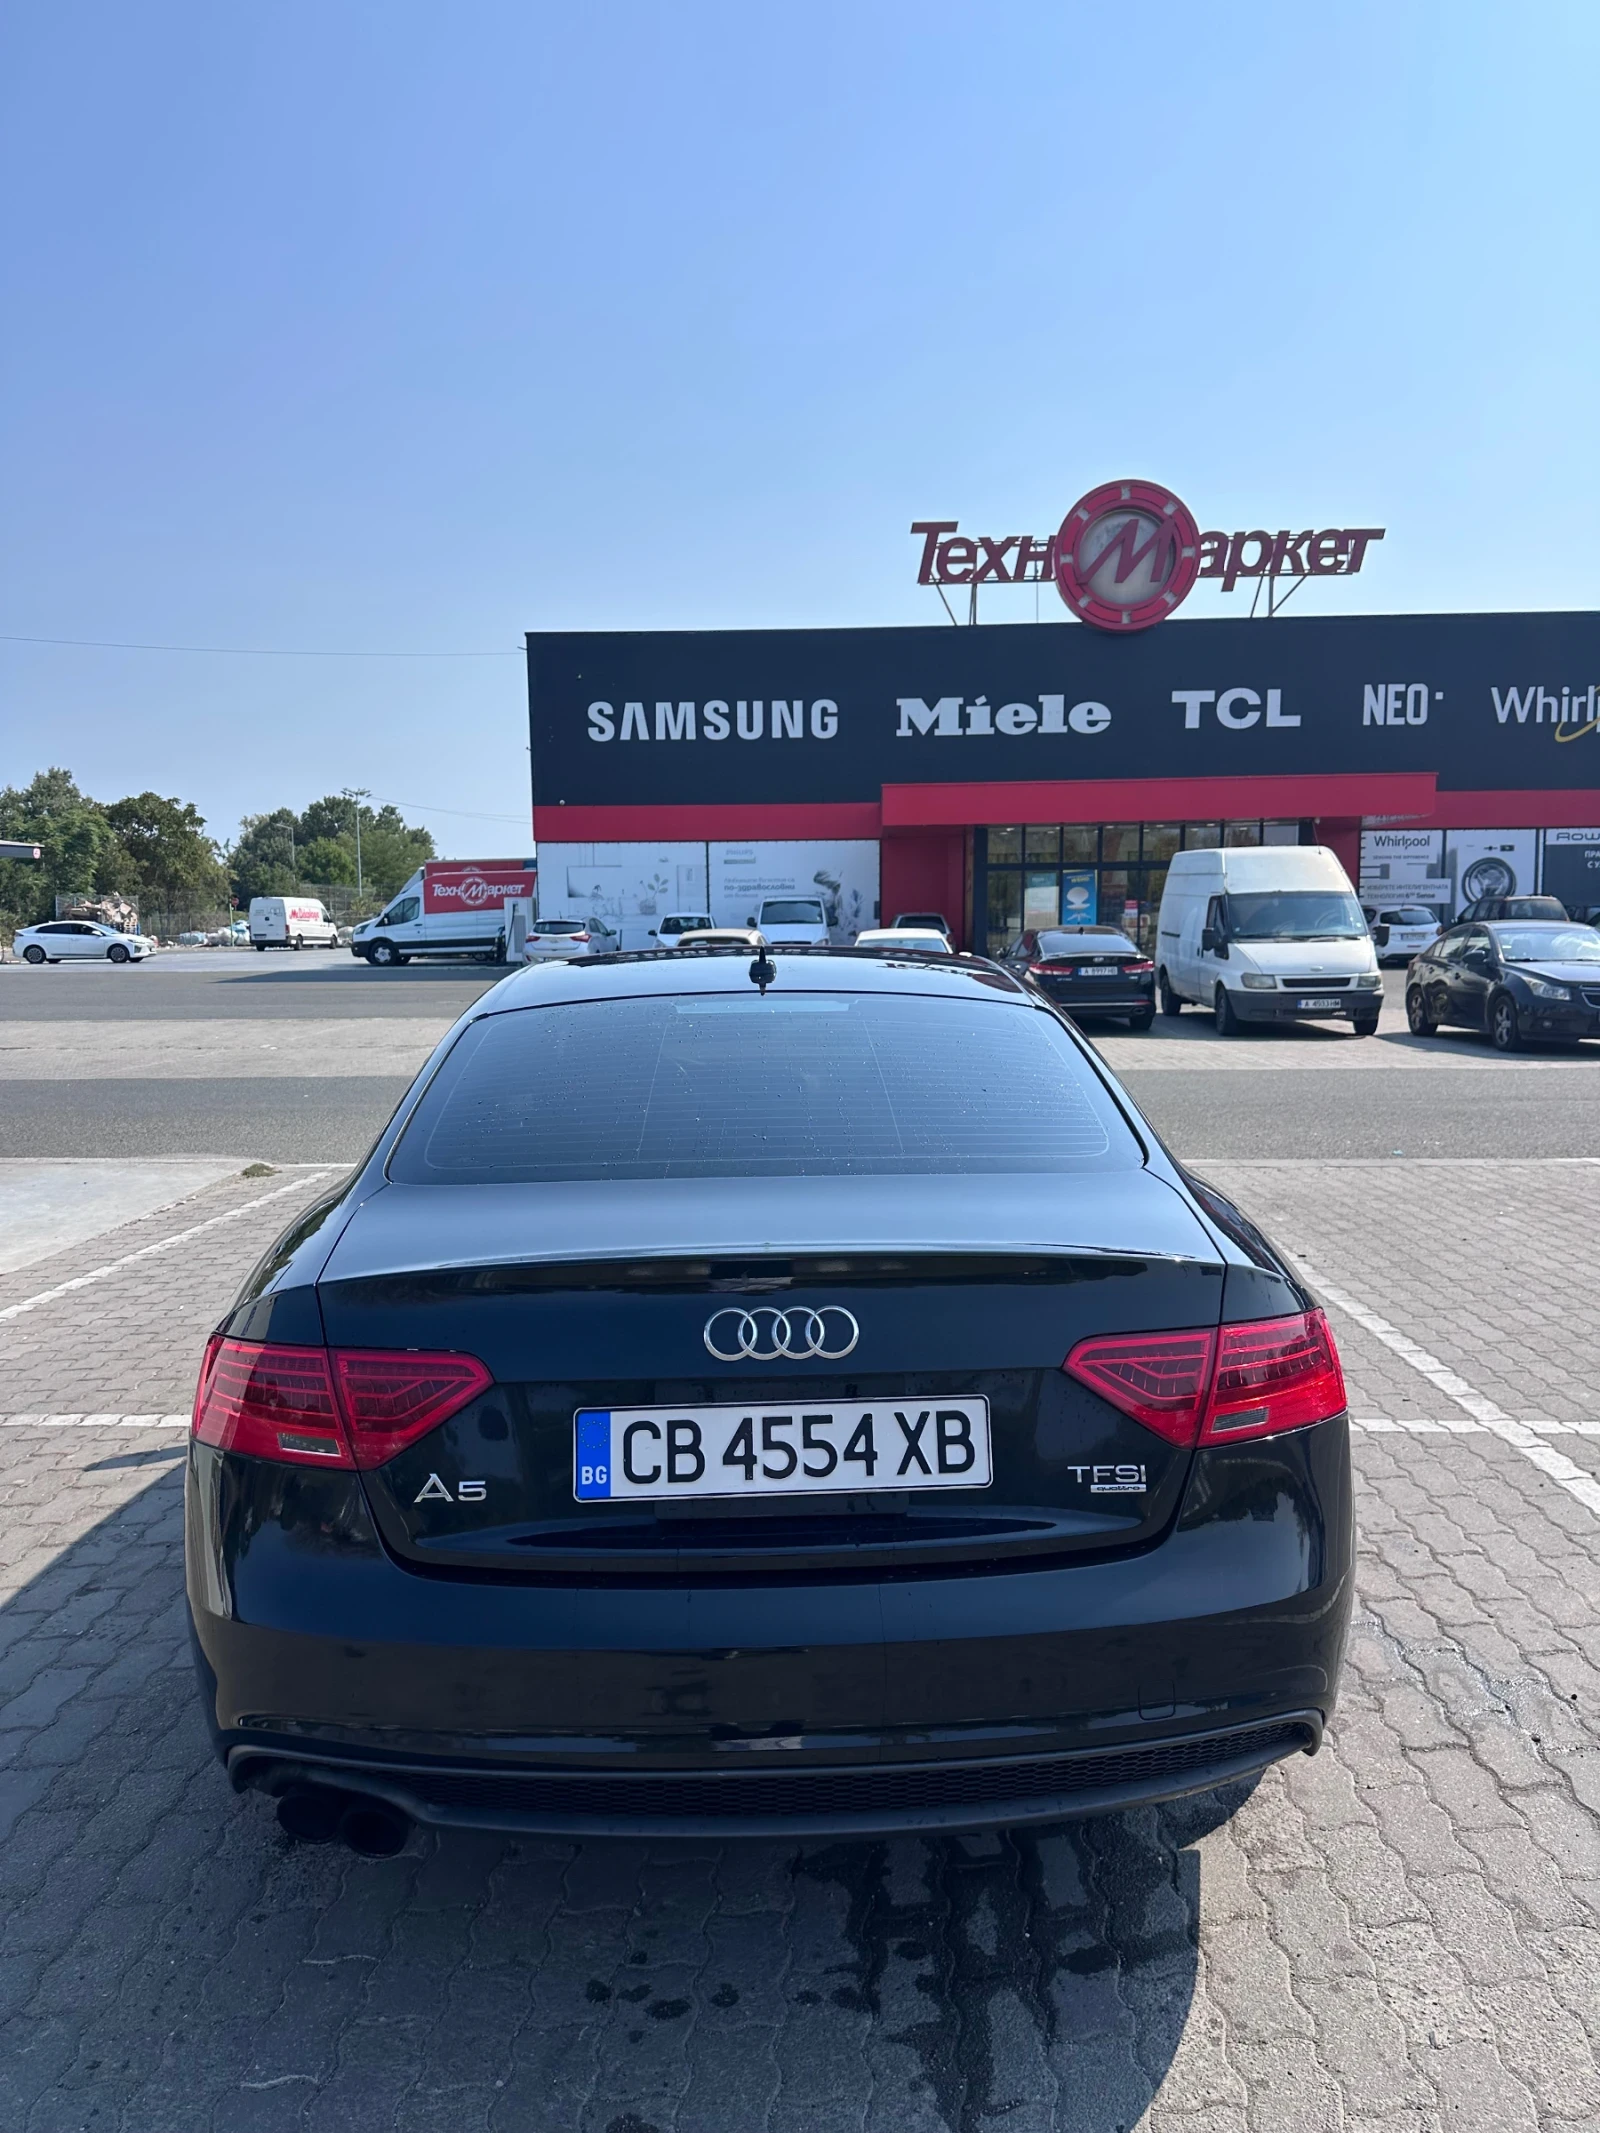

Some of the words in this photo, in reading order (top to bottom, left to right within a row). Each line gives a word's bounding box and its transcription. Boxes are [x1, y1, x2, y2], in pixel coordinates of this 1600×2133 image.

[587, 699, 839, 742] SAMSUNG
[895, 694, 1112, 737] Miele
[1171, 687, 1301, 730] TCL
[1490, 685, 1600, 733] Whirl
[1373, 834, 1431, 850] Whirlpool
[622, 1419, 706, 1485] CB
[722, 1412, 879, 1481] 4554
[893, 1410, 976, 1475] XB
[413, 1473, 487, 1503] A5
[581, 1465, 608, 1485] BG
[1067, 1464, 1147, 1483] TFSI
